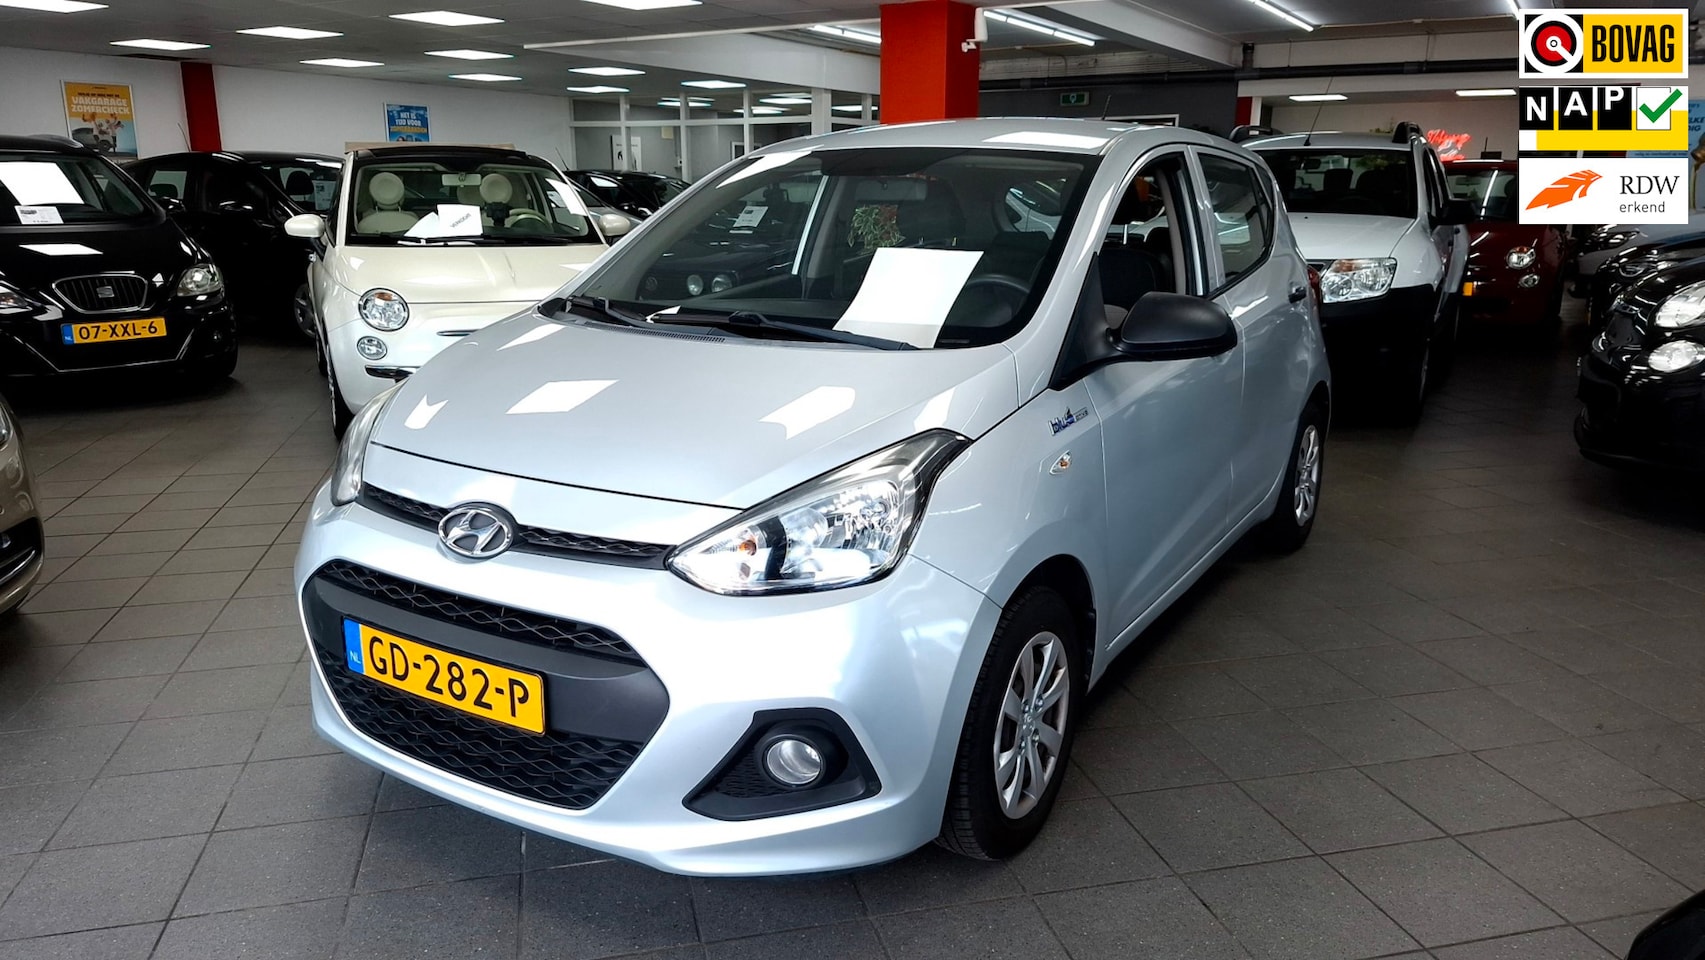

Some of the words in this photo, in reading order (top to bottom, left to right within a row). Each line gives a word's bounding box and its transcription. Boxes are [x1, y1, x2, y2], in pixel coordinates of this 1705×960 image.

[72, 96, 128, 106] VAKGARAGE
[71, 105, 130, 114] ZOMERCHECK
[79, 321, 158, 340] 07-XXL-6
[350, 650, 362, 664] NL
[369, 636, 530, 718] GD-282-P
